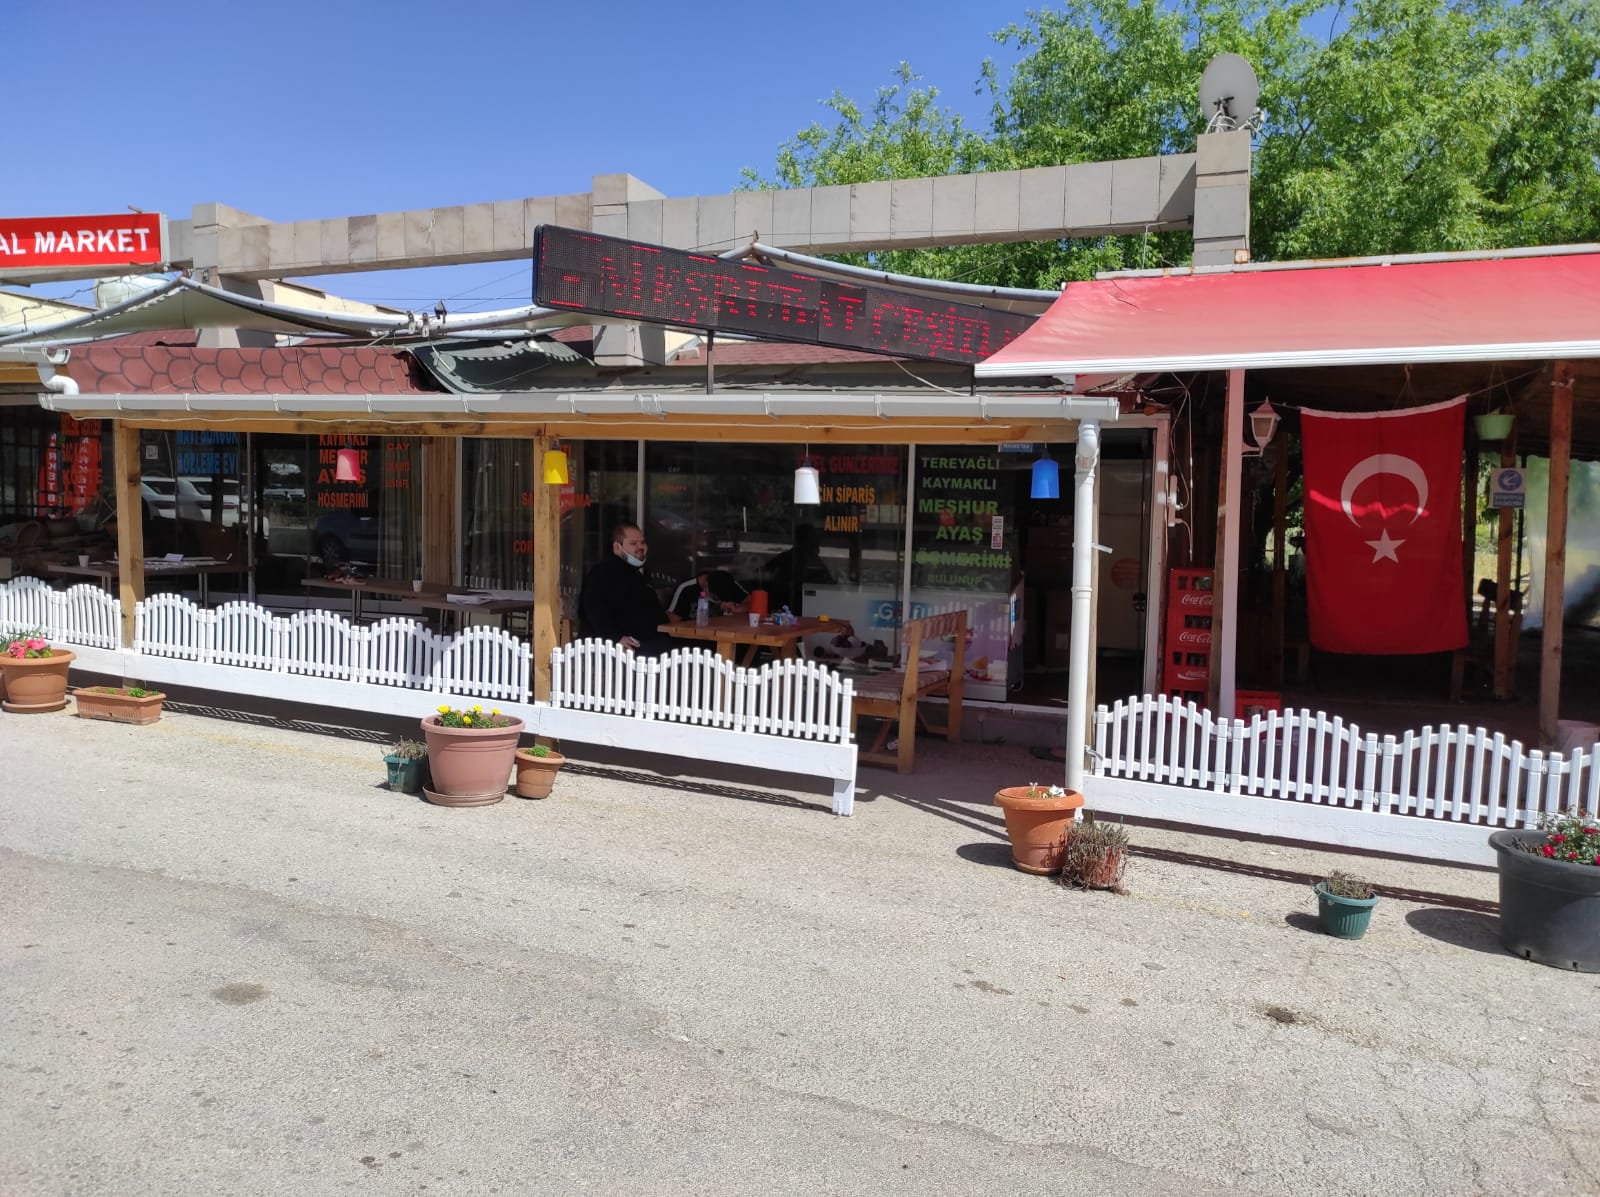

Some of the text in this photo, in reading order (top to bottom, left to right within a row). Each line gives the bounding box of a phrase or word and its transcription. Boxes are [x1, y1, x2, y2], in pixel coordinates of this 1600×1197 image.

[34, 228, 150, 254] MARKET
[320, 449, 368, 465] MER
[921, 456, 1000, 470] TEREYAĞLI
[922, 477, 997, 490] KAYMAKLI
[936, 526, 984, 545] AYAŞ
